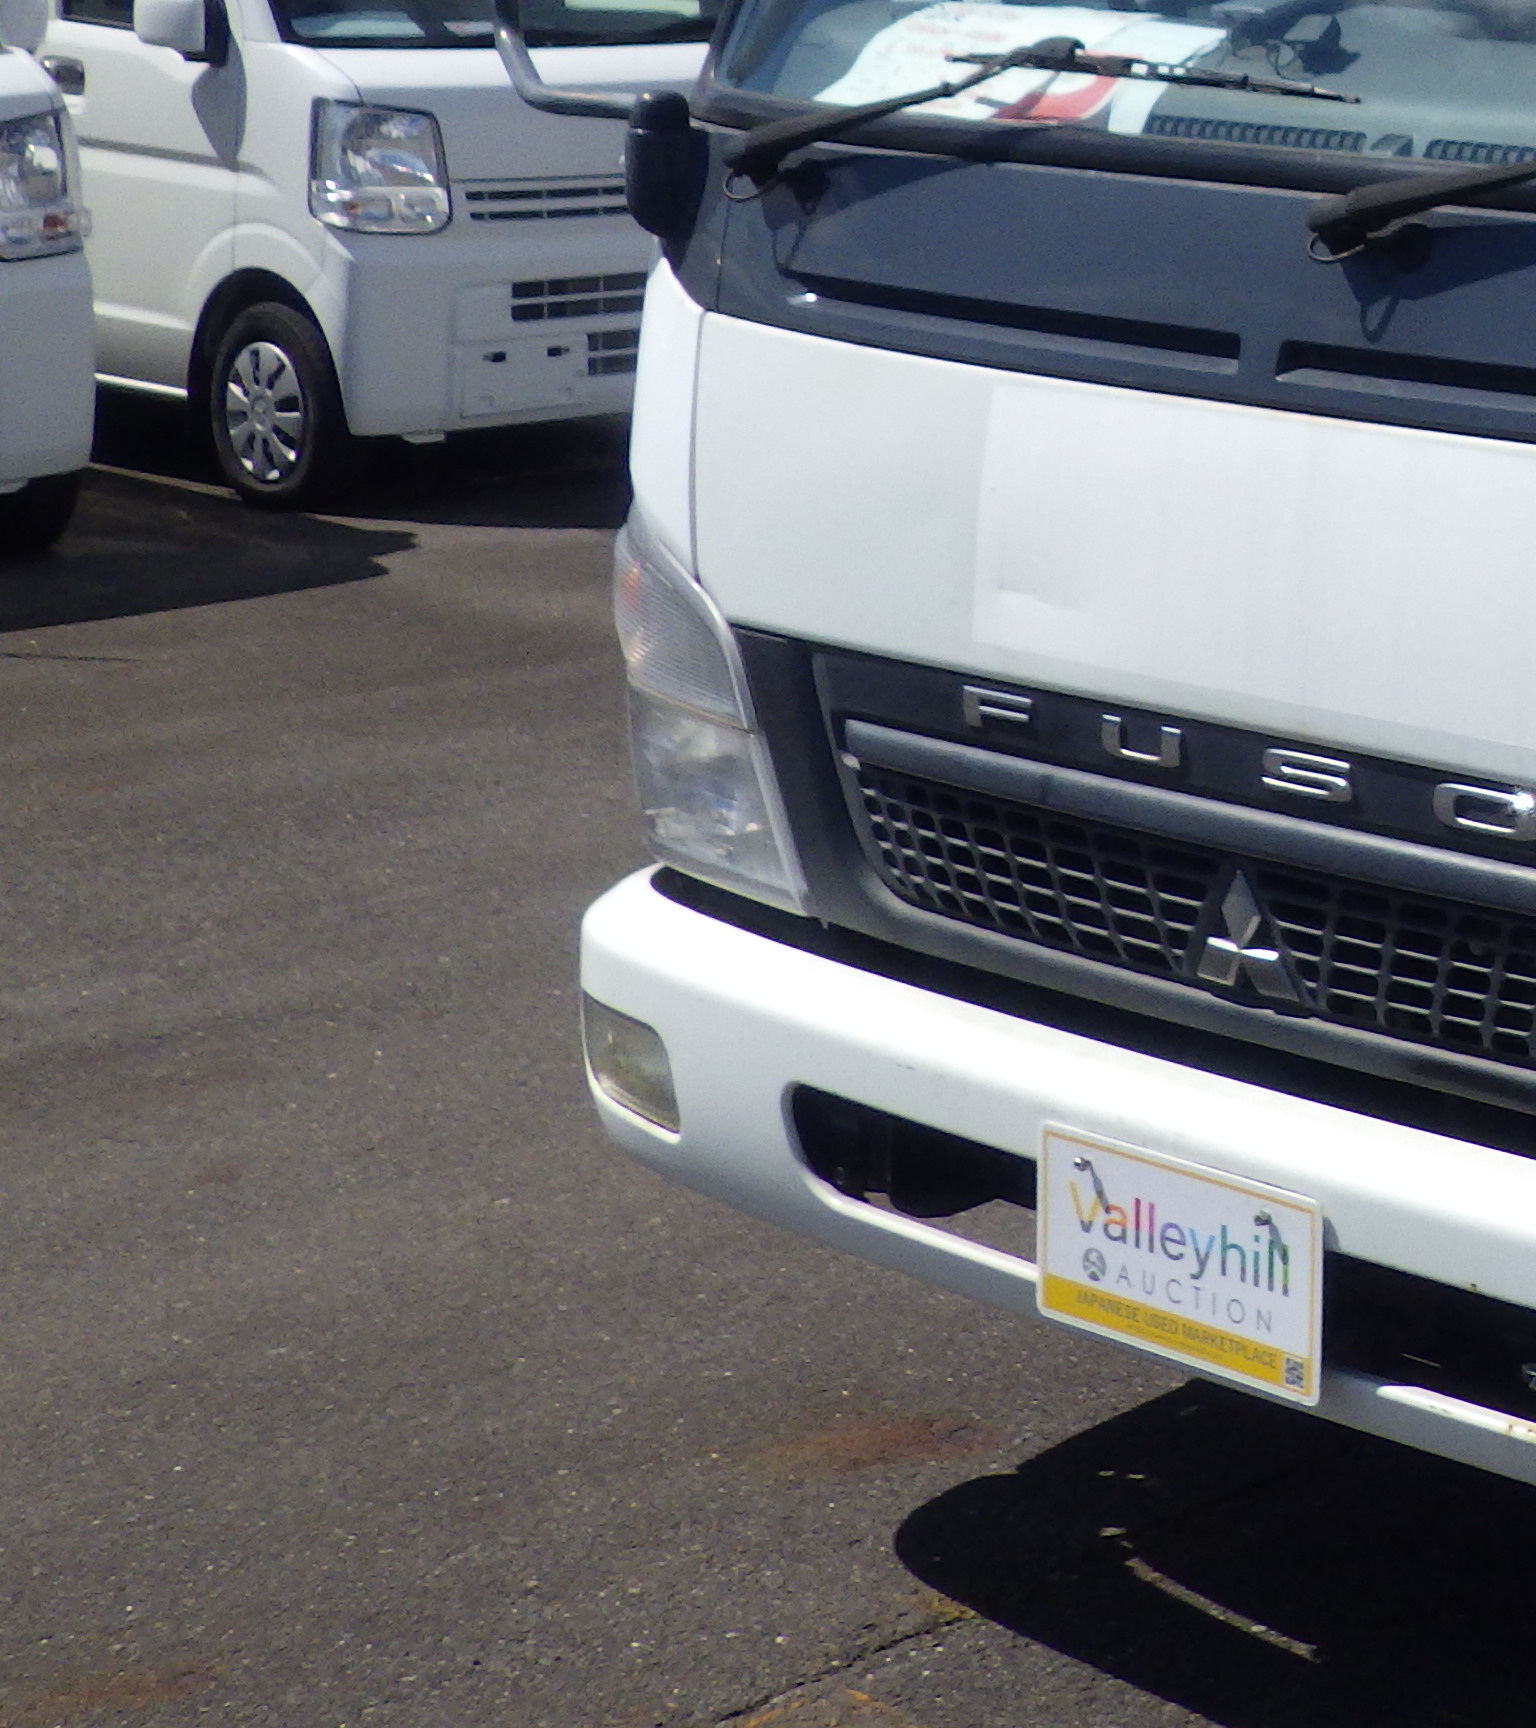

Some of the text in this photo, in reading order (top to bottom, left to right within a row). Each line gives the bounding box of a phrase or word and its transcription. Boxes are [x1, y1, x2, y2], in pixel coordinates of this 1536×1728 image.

[1076, 1289, 1140, 1323] JAPANESE
[1181, 1322, 1278, 1370] MARKETPLACE
[1115, 1264, 1273, 1334] AUCTION
